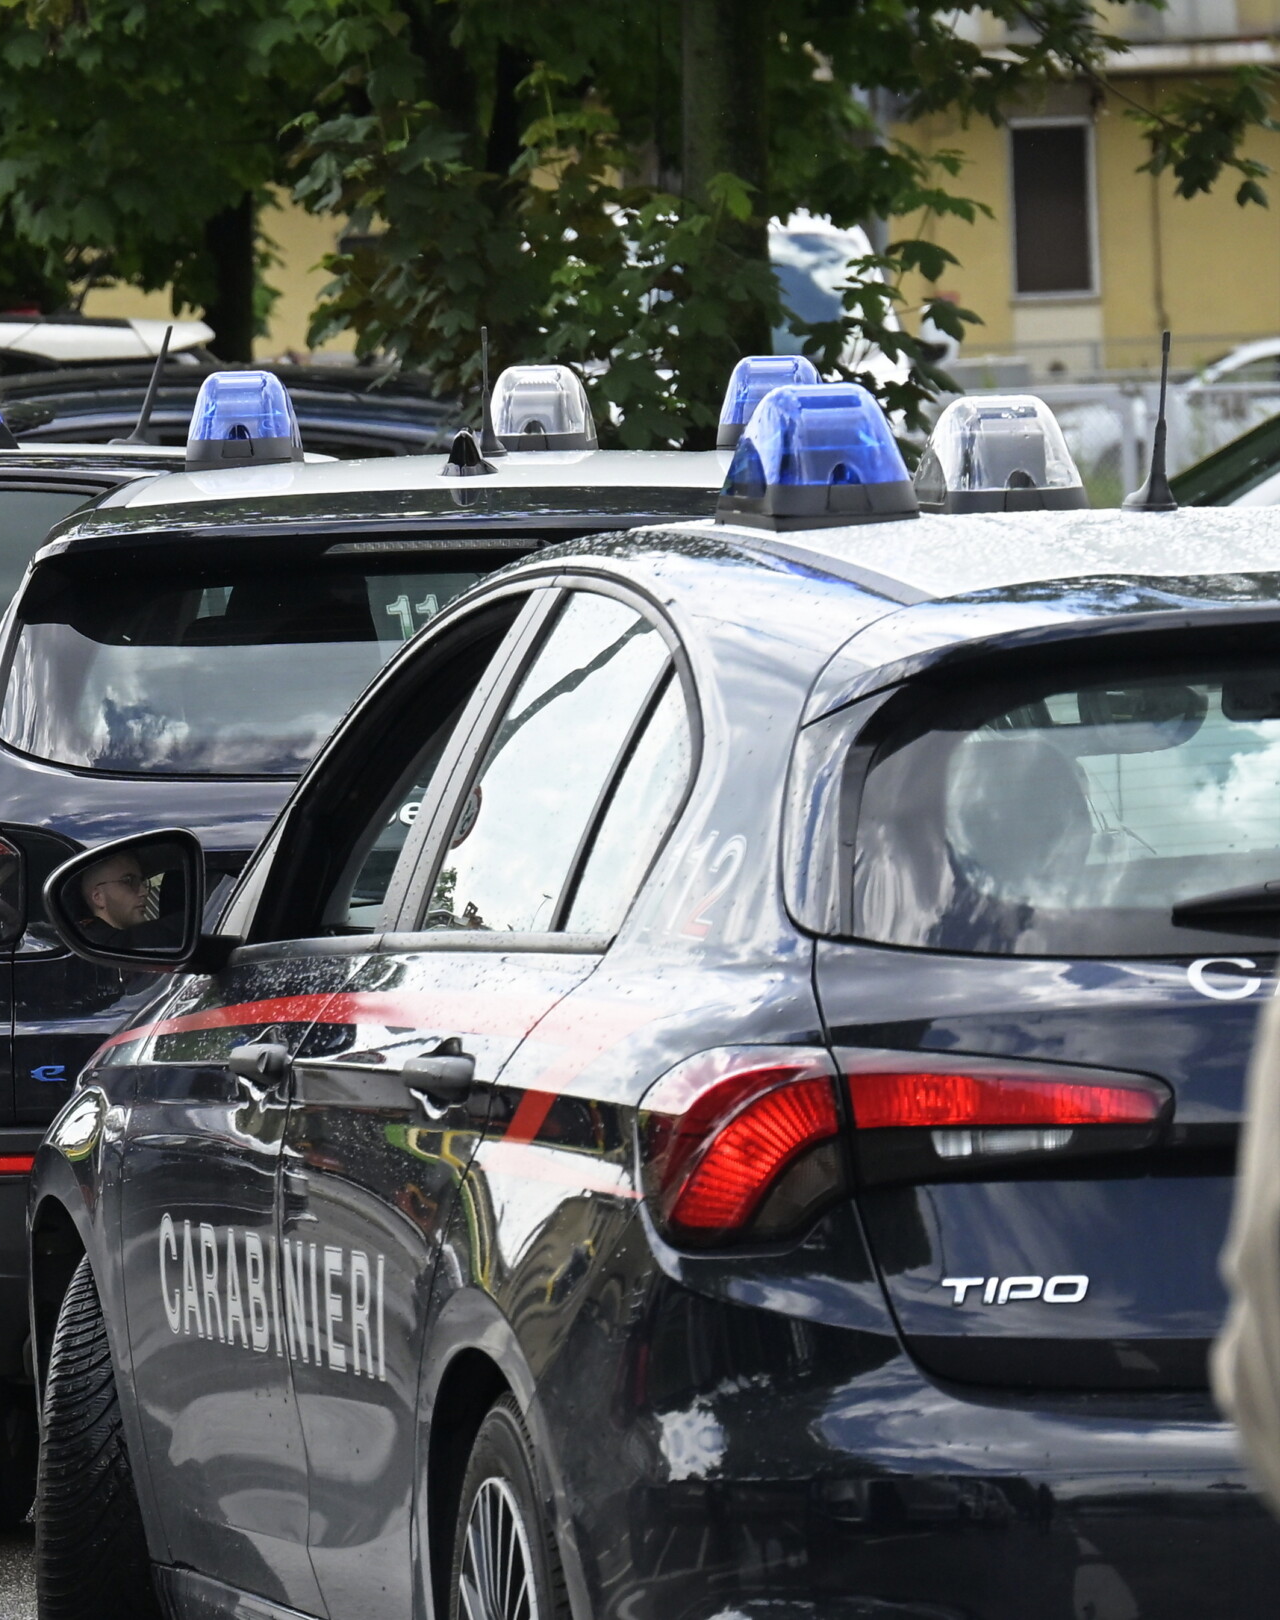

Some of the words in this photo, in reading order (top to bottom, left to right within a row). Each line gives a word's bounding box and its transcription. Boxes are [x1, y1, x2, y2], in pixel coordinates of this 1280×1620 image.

[386, 594, 459, 640] 11
[160, 1213, 386, 1381] CARABINIERI
[942, 1275, 1089, 1305] TIPO
